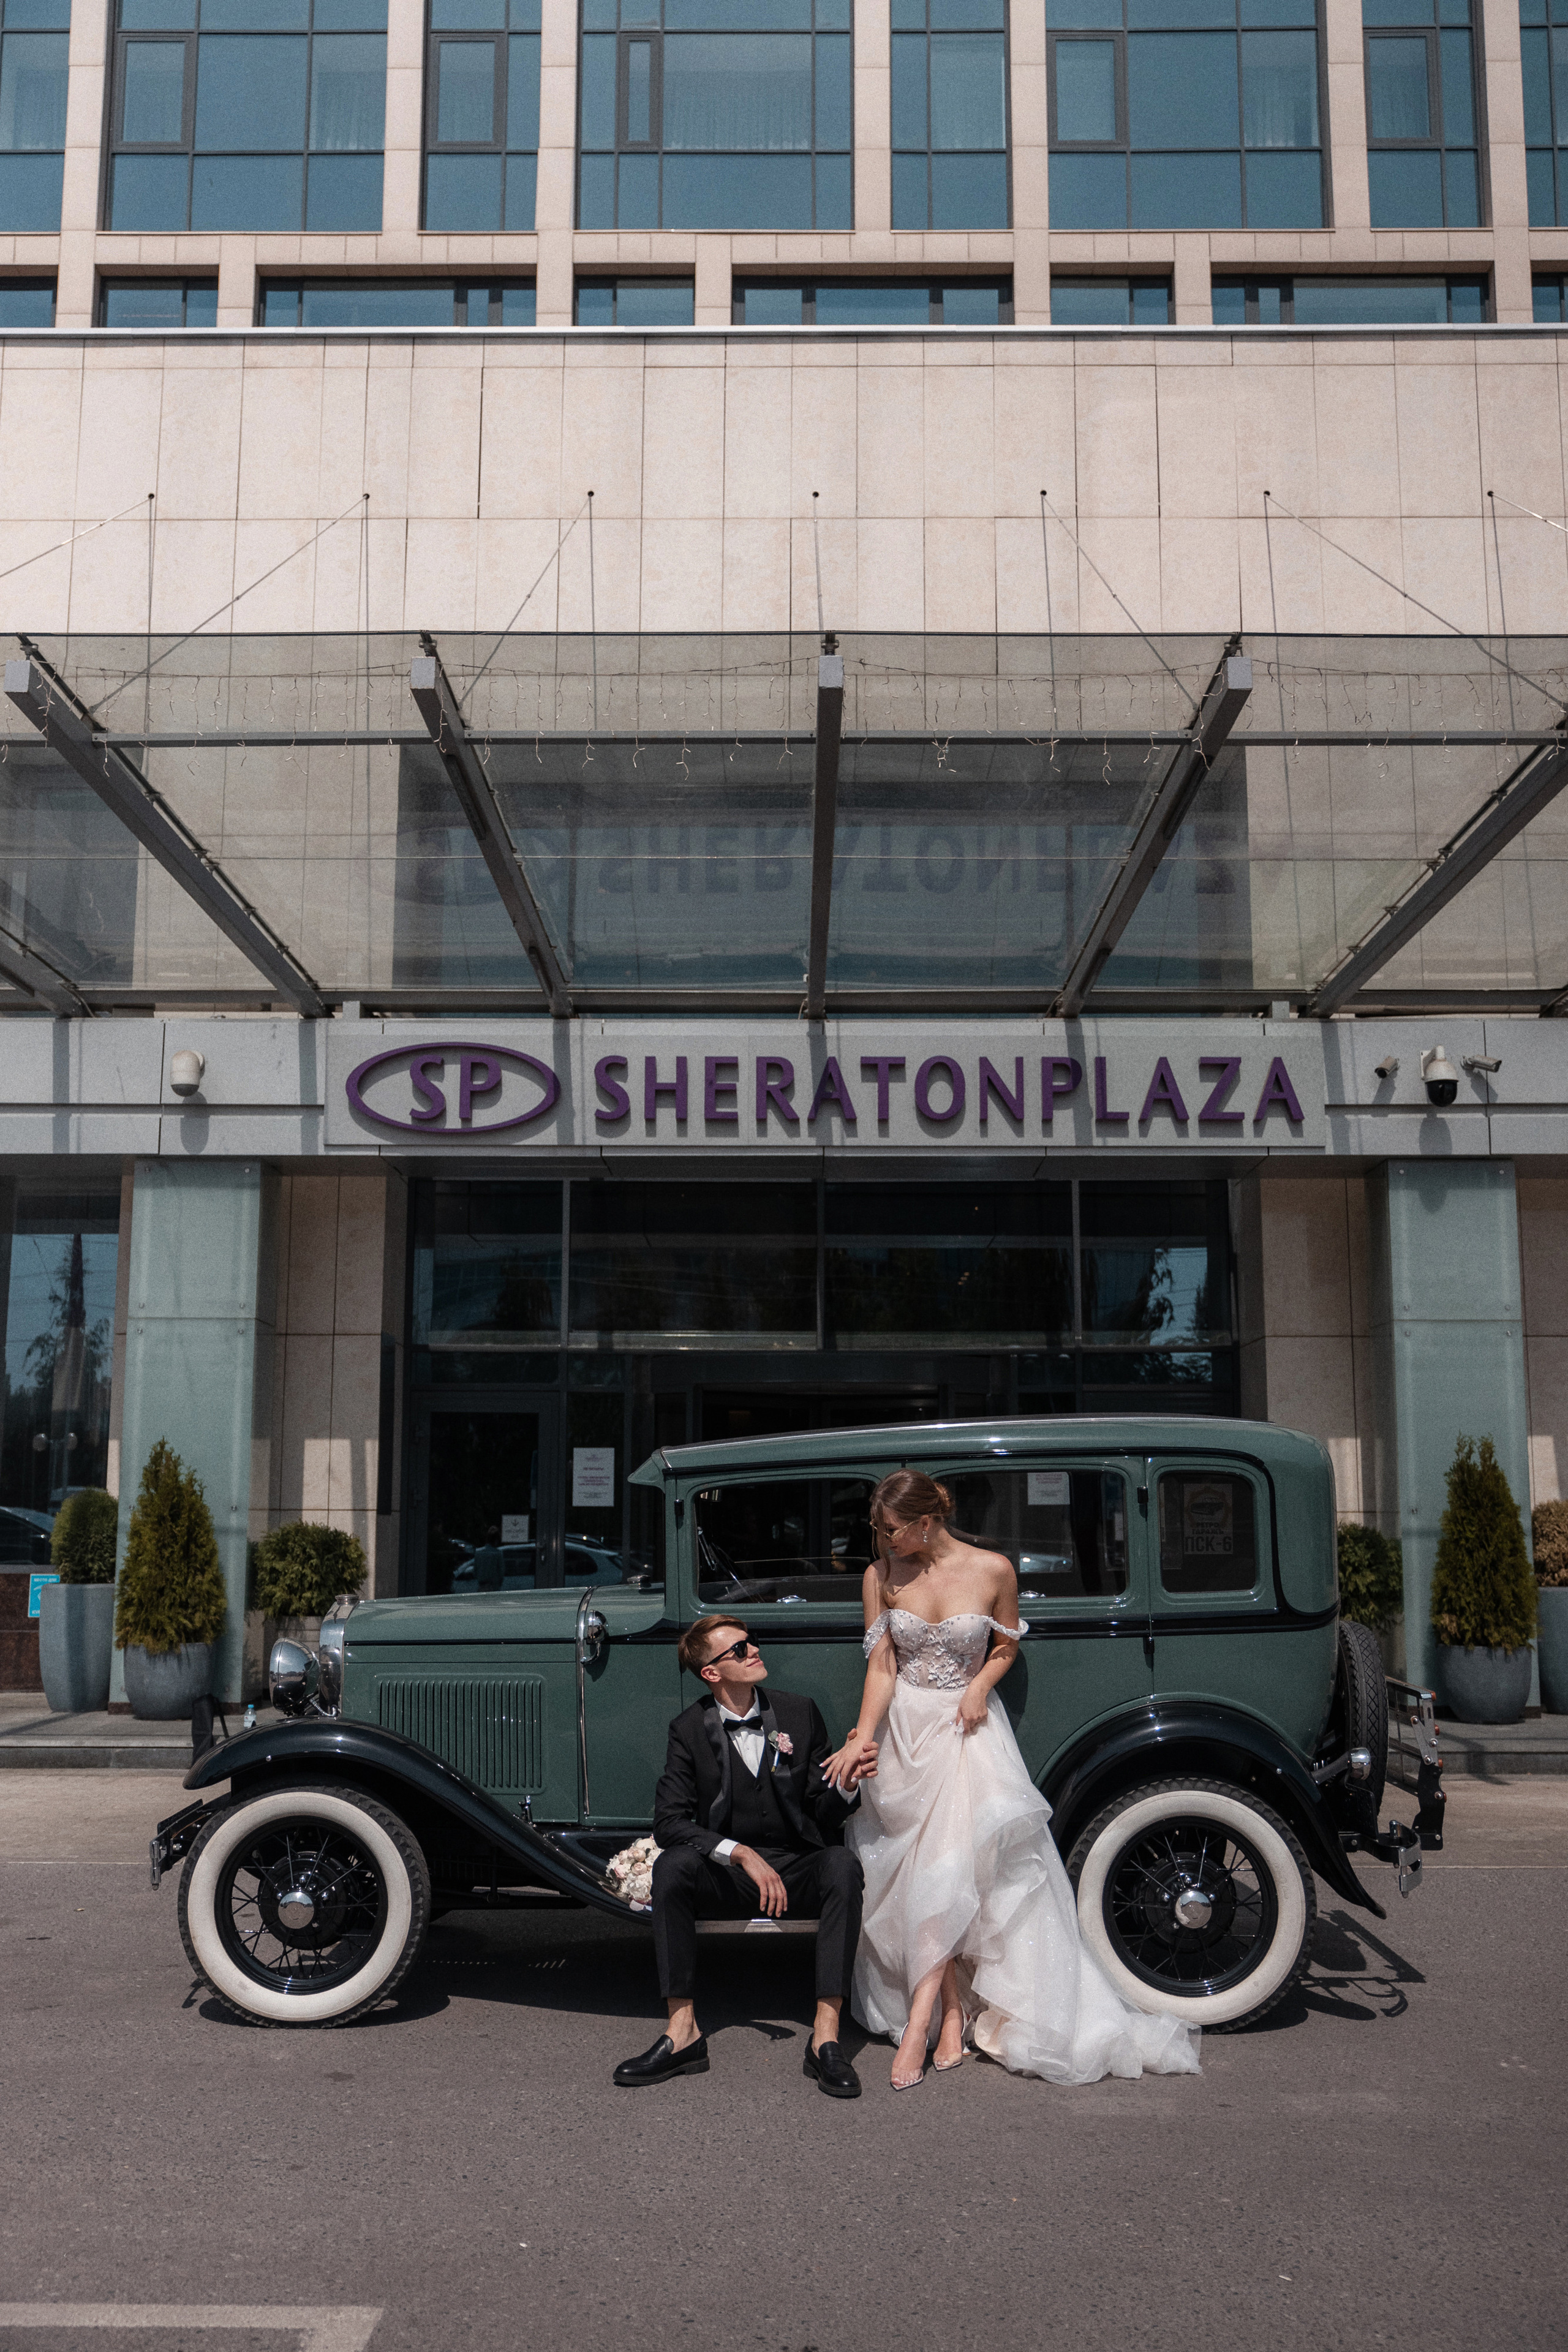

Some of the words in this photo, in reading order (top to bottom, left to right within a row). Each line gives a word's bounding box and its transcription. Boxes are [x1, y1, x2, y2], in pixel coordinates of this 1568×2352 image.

[409, 1054, 502, 1120] SP
[594, 1055, 1305, 1120] SHERATONPLAZA
[1185, 1536, 1232, 1553] ПСК-6
